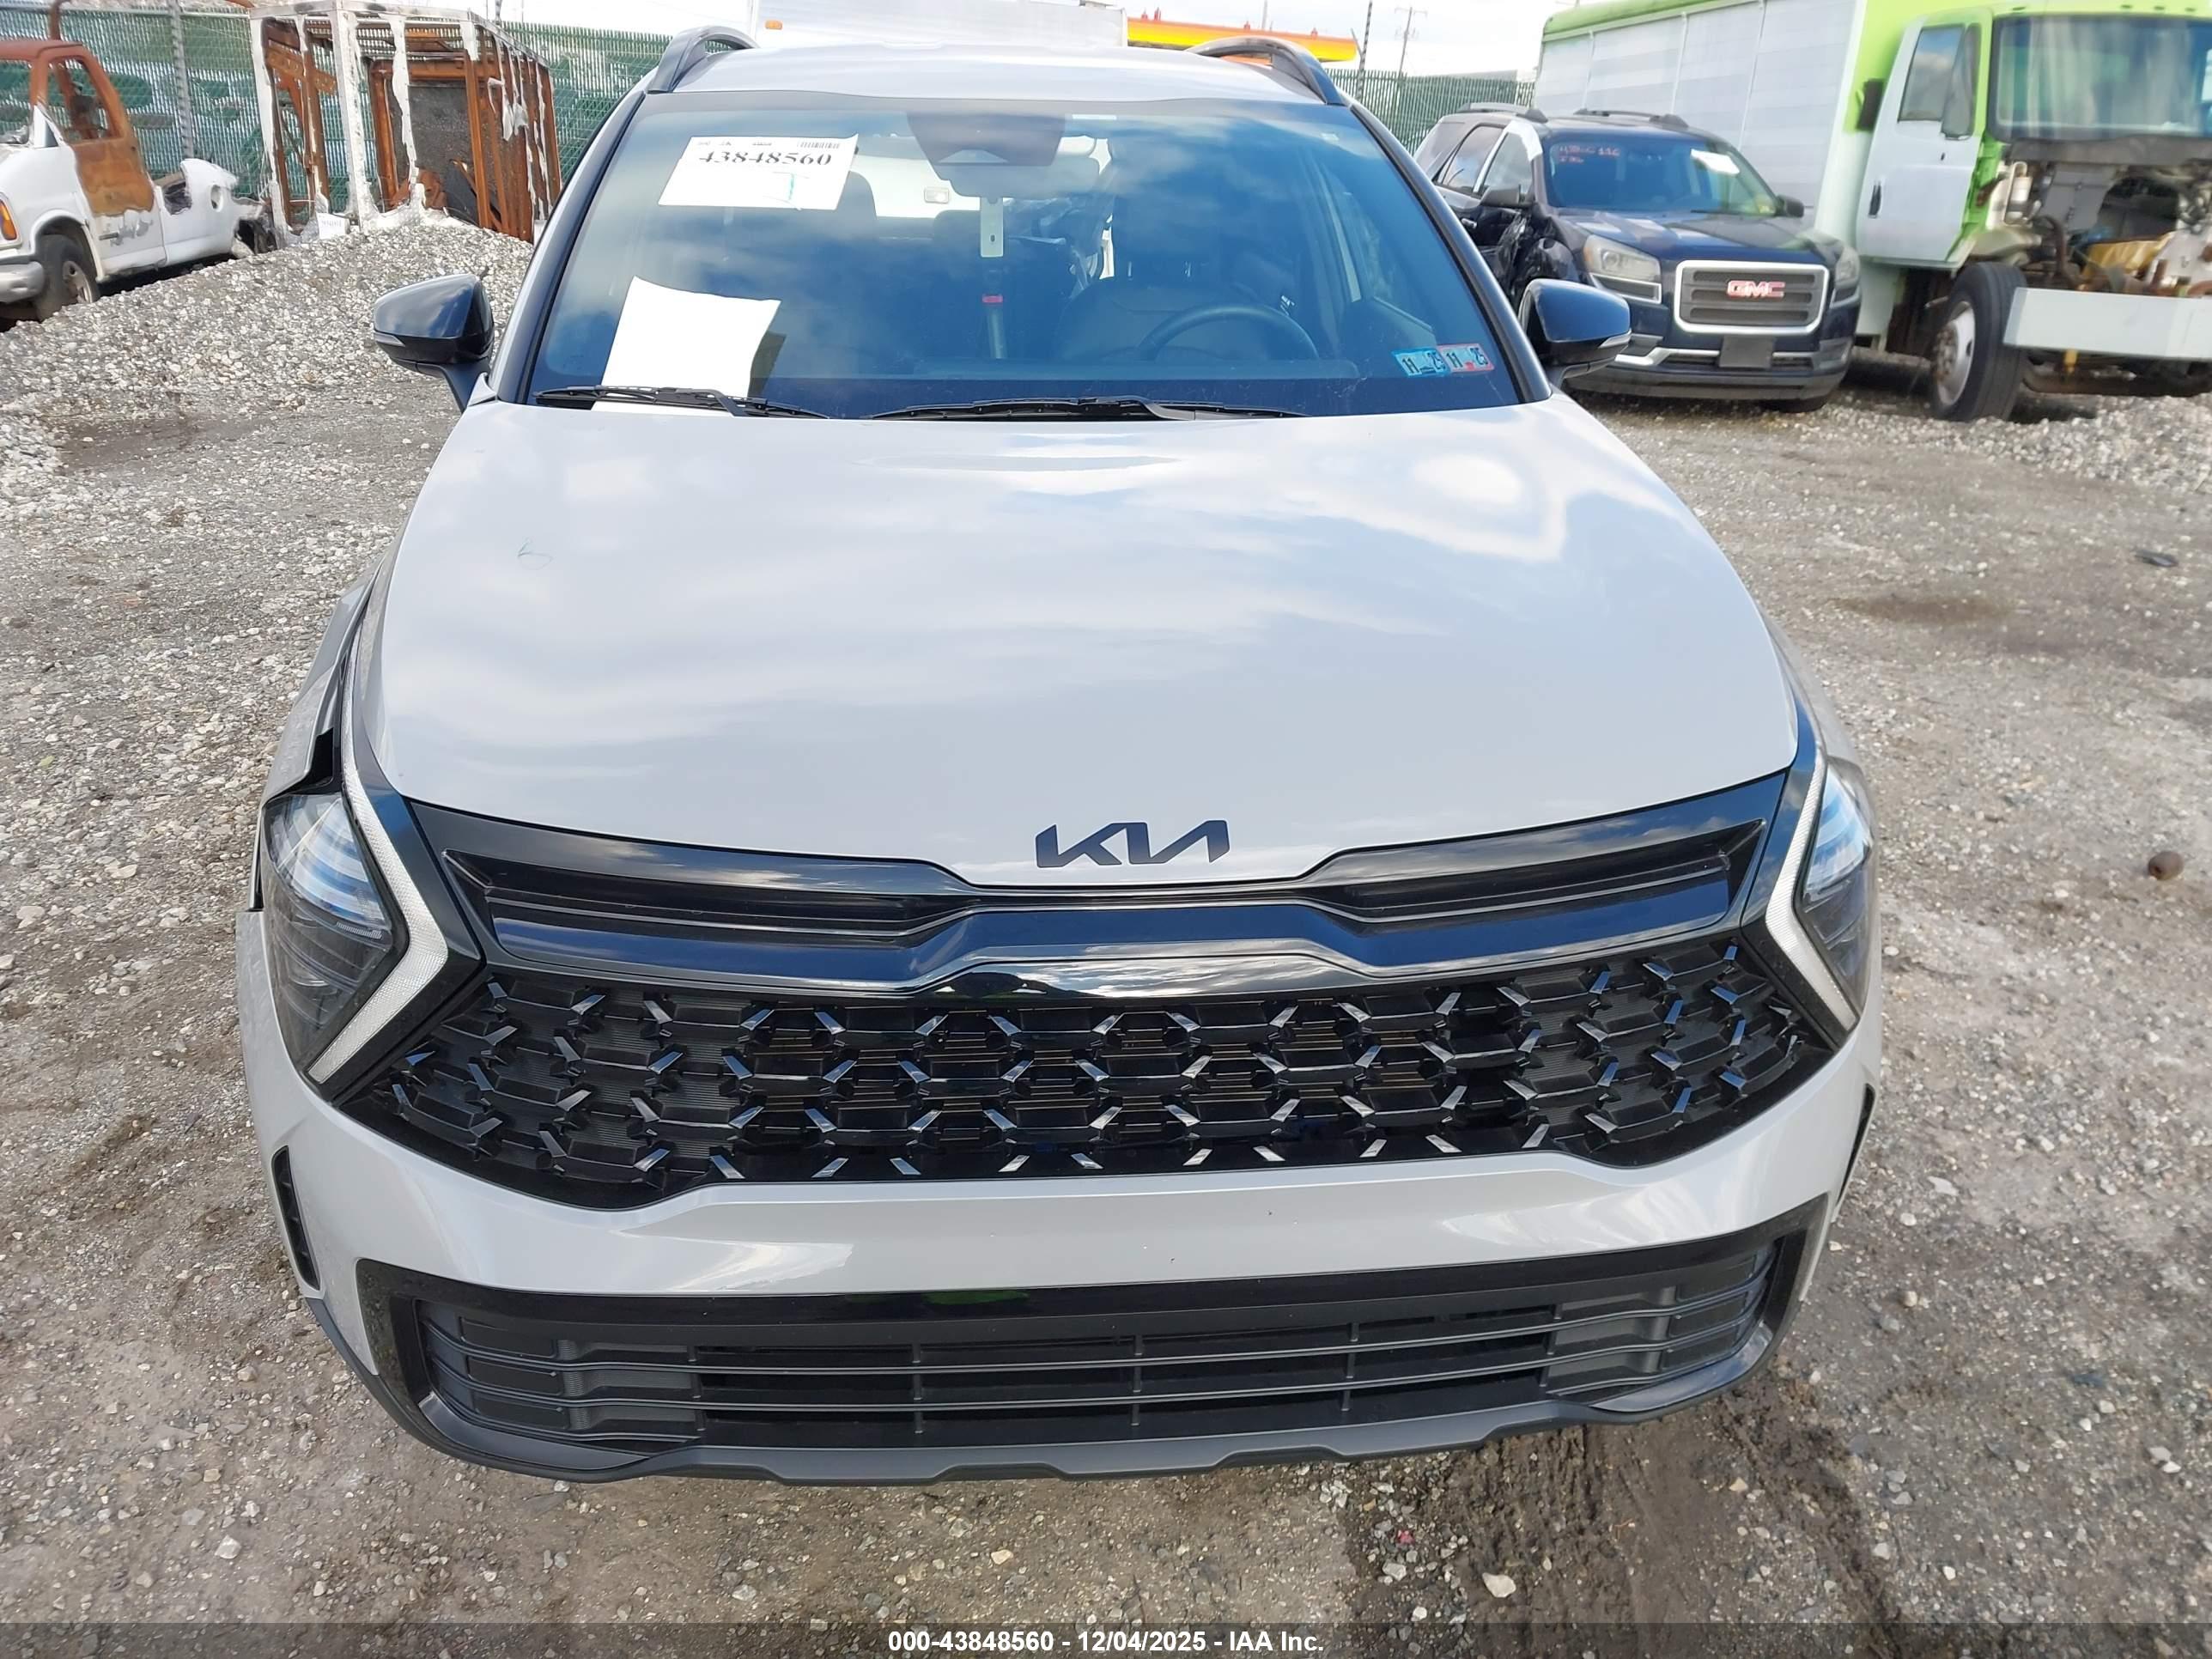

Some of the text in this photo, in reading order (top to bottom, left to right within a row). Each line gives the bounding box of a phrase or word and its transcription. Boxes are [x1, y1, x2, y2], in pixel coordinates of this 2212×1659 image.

[699, 150, 832, 166] 43848560
[1727, 280, 1785, 298] GMC
[1446, 352, 1464, 368] 11
